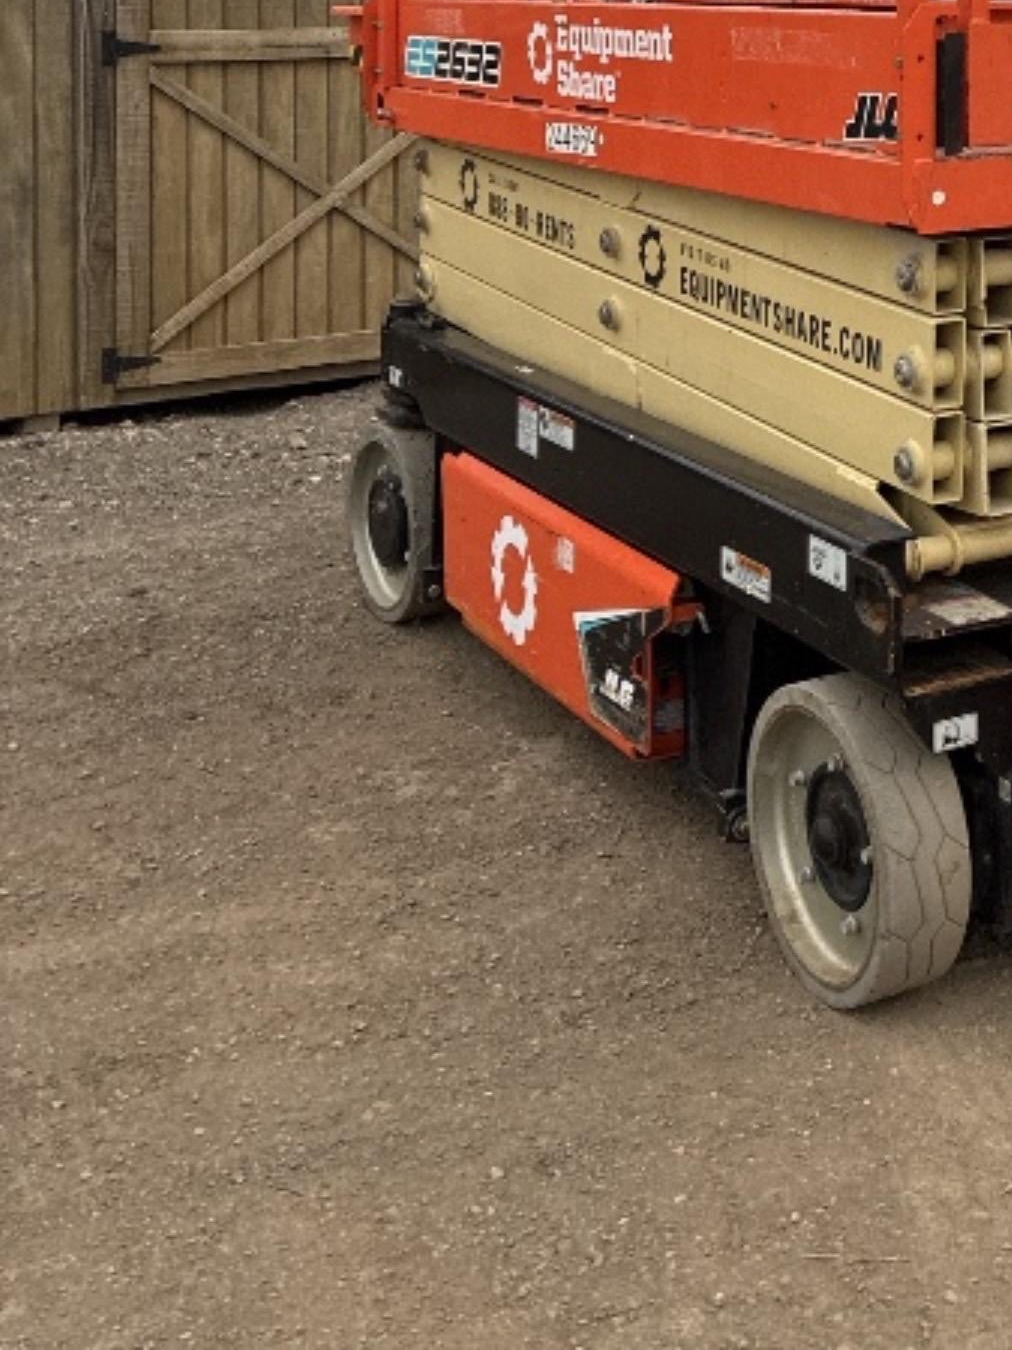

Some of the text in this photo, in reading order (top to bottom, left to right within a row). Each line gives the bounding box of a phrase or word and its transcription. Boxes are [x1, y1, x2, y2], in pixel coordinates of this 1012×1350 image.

[553, 13, 673, 64] Equipment
[556, 59, 617, 104] Share
[679, 265, 884, 373] EQUIPMENTSHARE.COM
